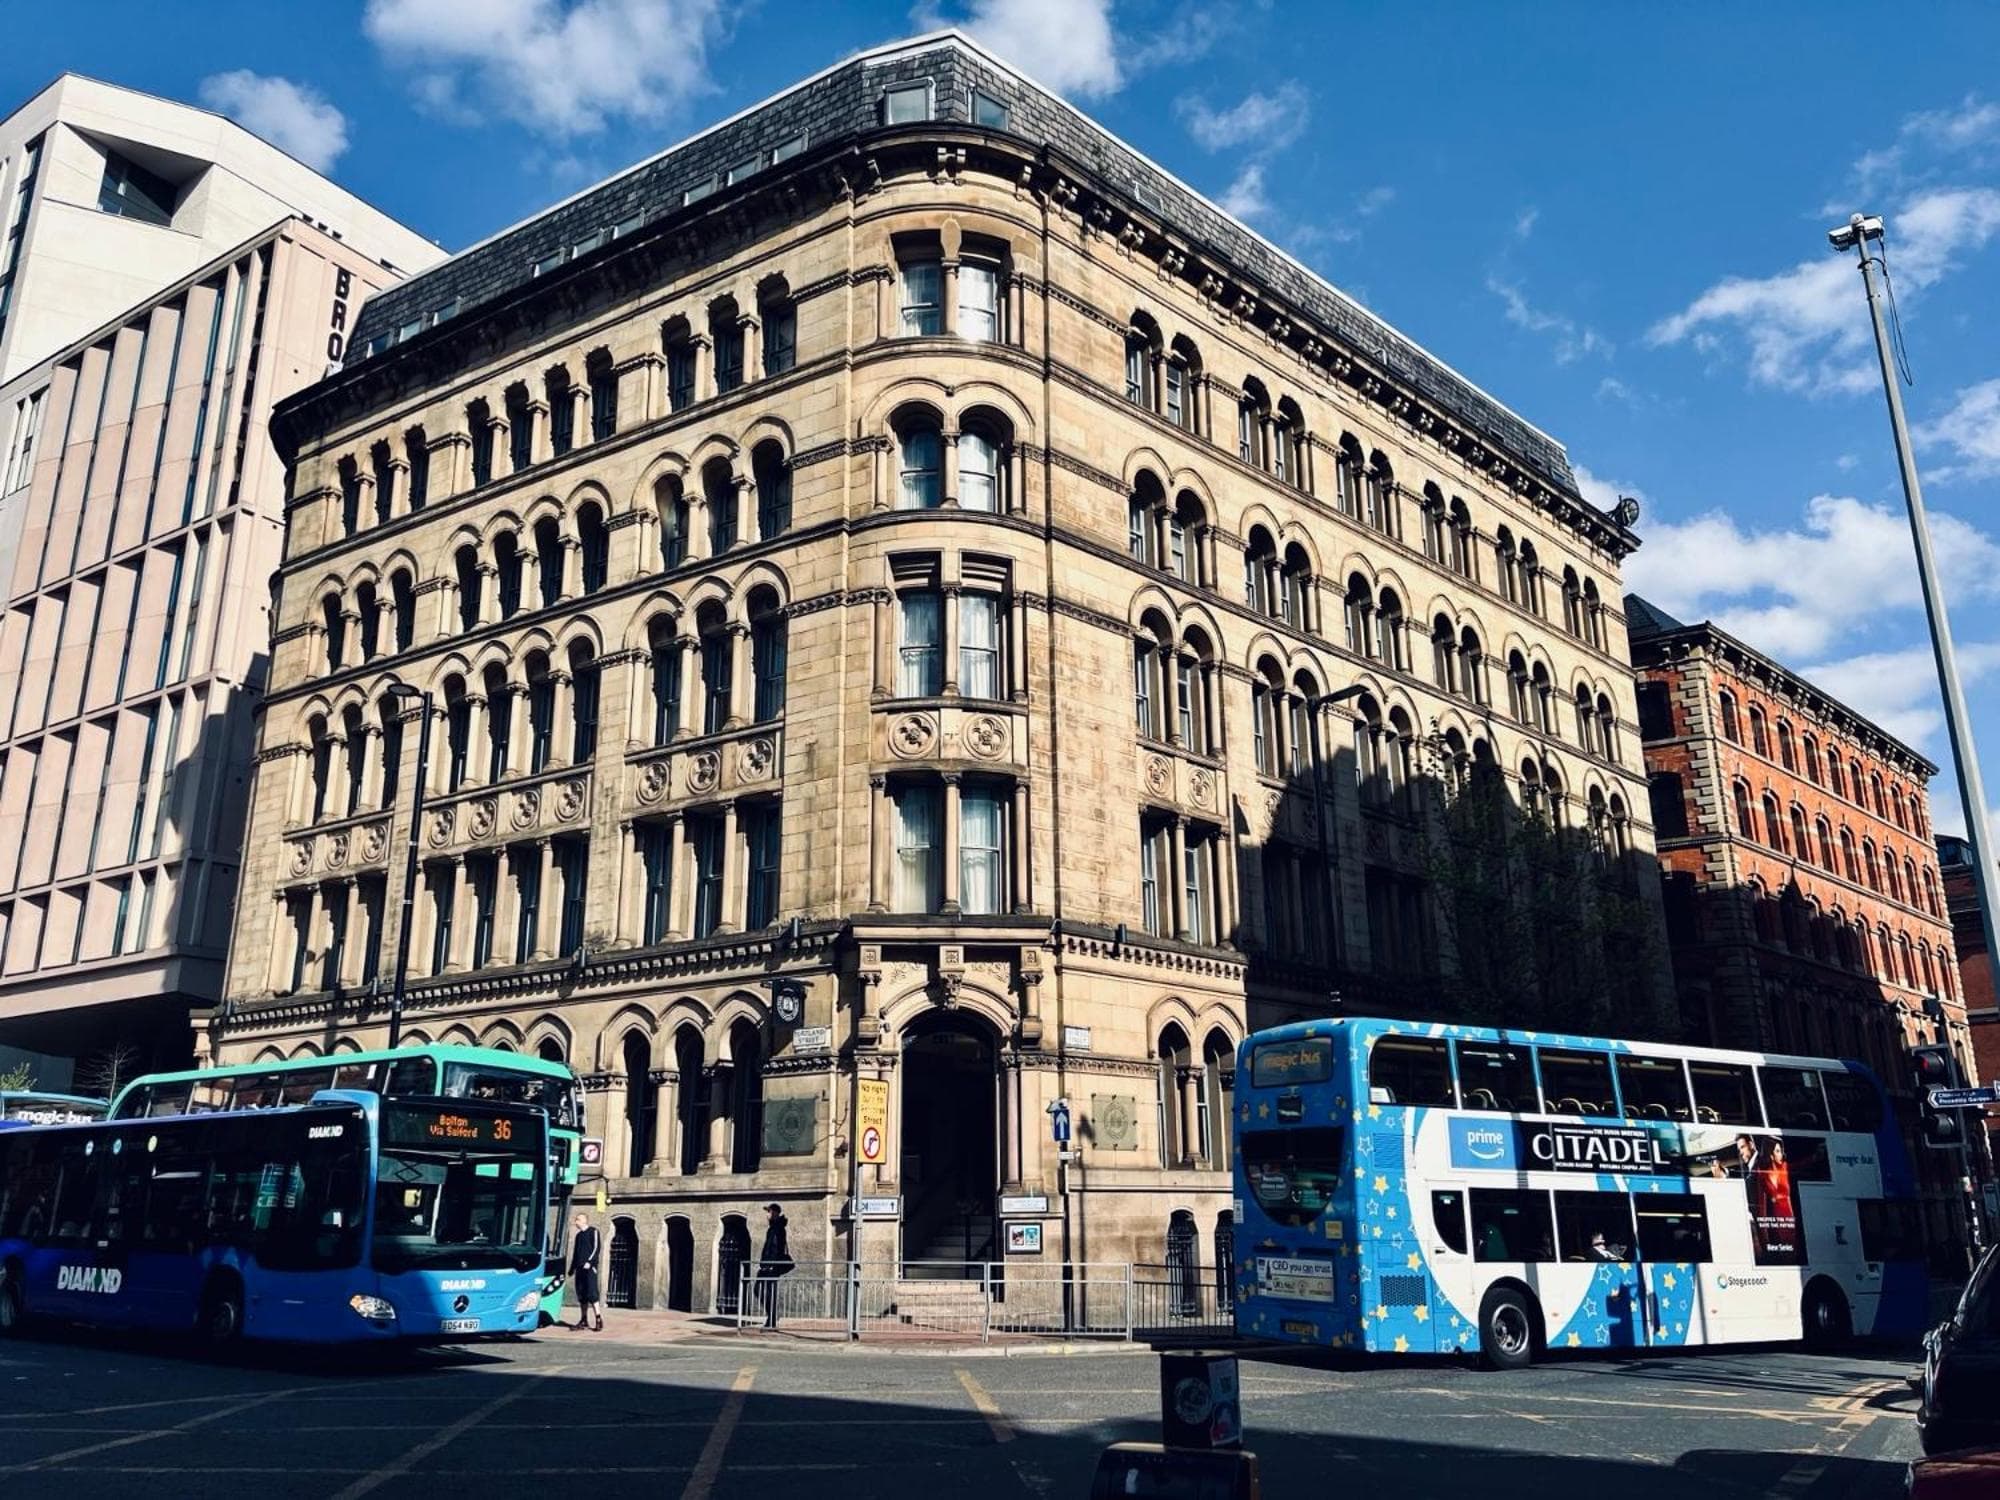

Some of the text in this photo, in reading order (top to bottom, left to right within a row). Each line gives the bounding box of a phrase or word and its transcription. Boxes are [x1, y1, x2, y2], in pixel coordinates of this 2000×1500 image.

[323, 267, 350, 372] BRO
[1301, 1048, 1321, 1065] bus
[18, 1110, 92, 1125] magic bus
[439, 1114, 468, 1127] Bolton
[446, 1126, 478, 1138] Salford
[493, 1119, 512, 1140] 36
[1467, 1128, 1504, 1146] prime
[1532, 1134, 1671, 1165] CITADEL
[1289, 1263, 1302, 1273] you
[1728, 1275, 1768, 1287] Stagecoach
